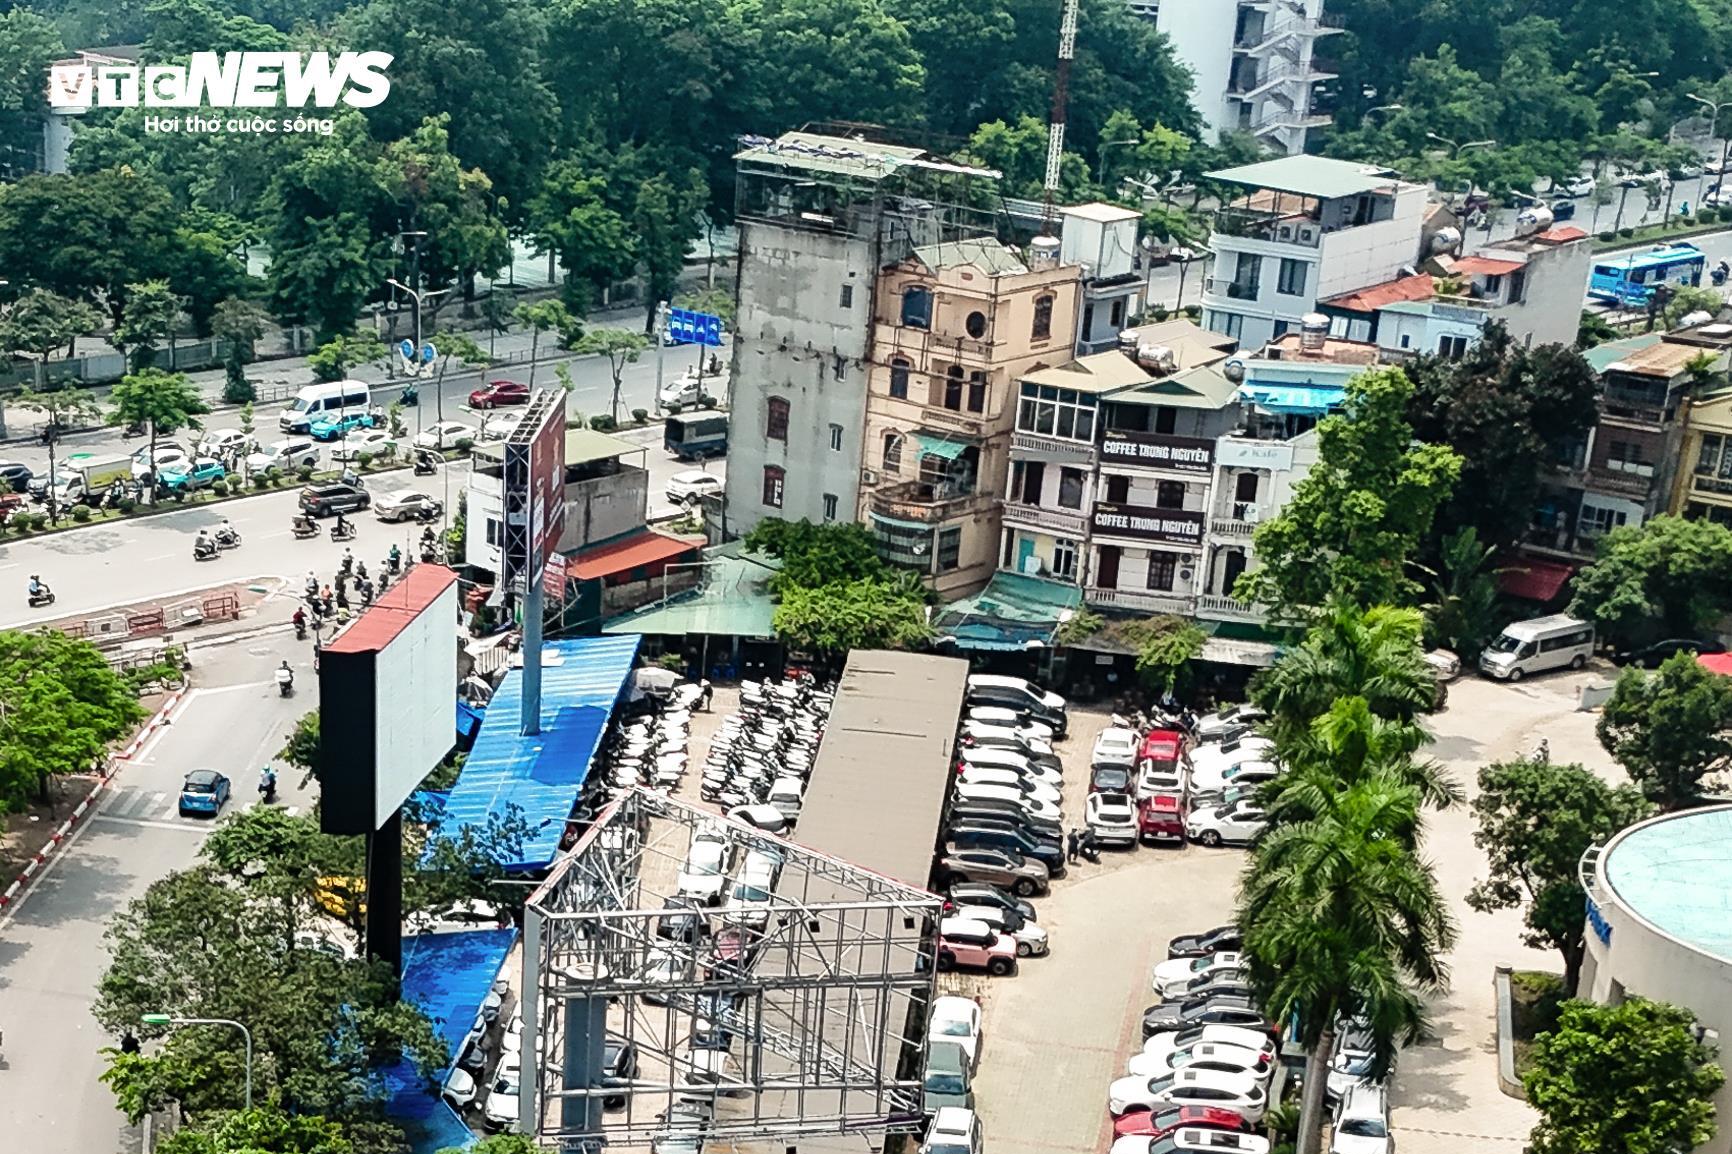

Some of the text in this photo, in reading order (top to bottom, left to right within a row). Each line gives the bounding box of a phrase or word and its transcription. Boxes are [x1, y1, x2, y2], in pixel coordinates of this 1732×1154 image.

[1103, 440, 1137, 456] COFFEE
[1171, 447, 1210, 463] NGUYÊN
[1095, 512, 1128, 528] COFFEE
[1161, 520, 1200, 535] NGUYÊN
